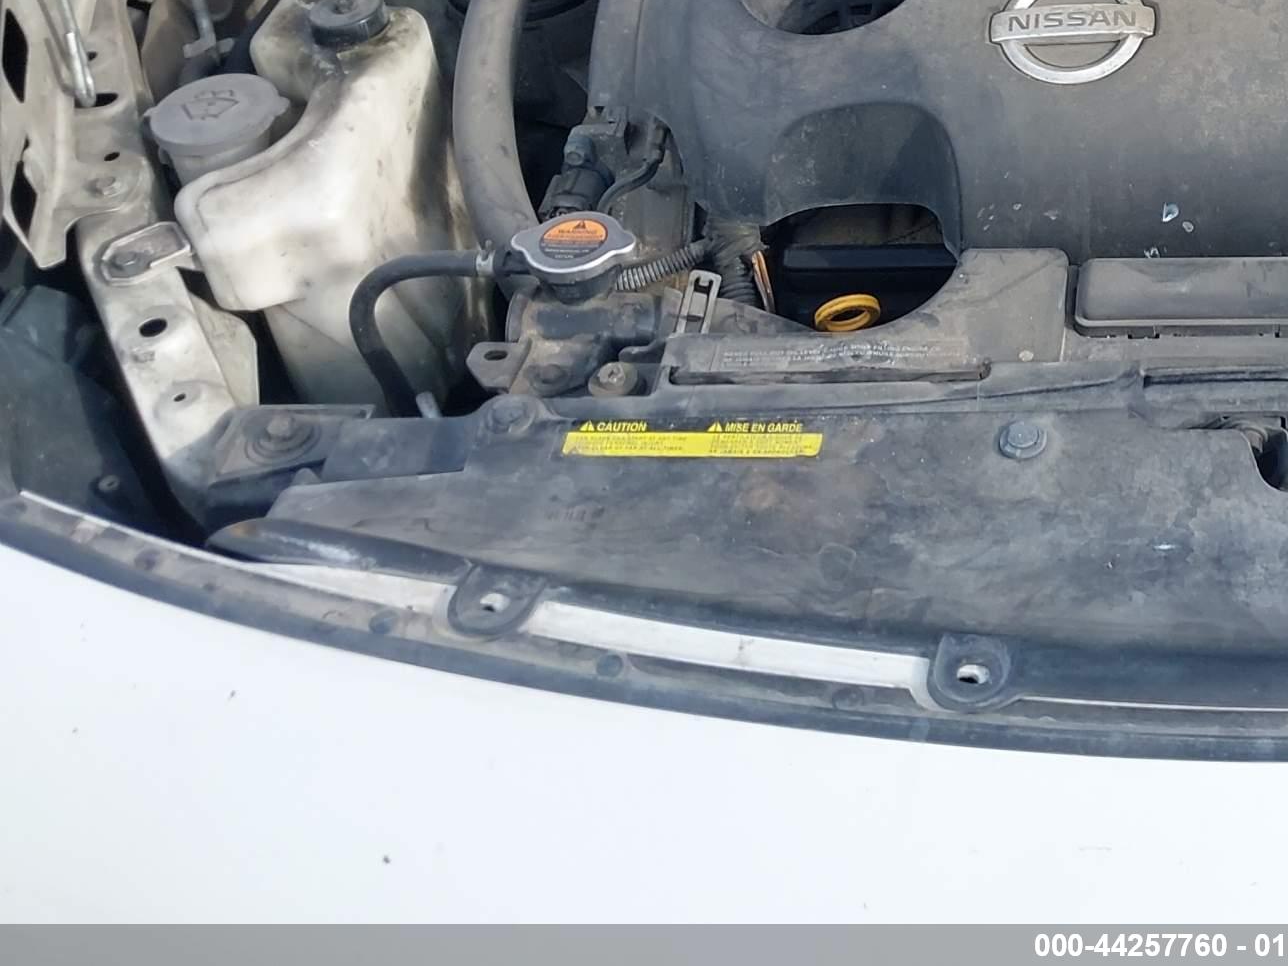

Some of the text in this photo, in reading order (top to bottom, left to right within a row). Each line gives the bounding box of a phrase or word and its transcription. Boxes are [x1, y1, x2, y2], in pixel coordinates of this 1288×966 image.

[1007, 9, 1137, 32] NISSAN
[596, 421, 648, 432] CAUTION
[725, 422, 803, 433] MISE EN GARDE
